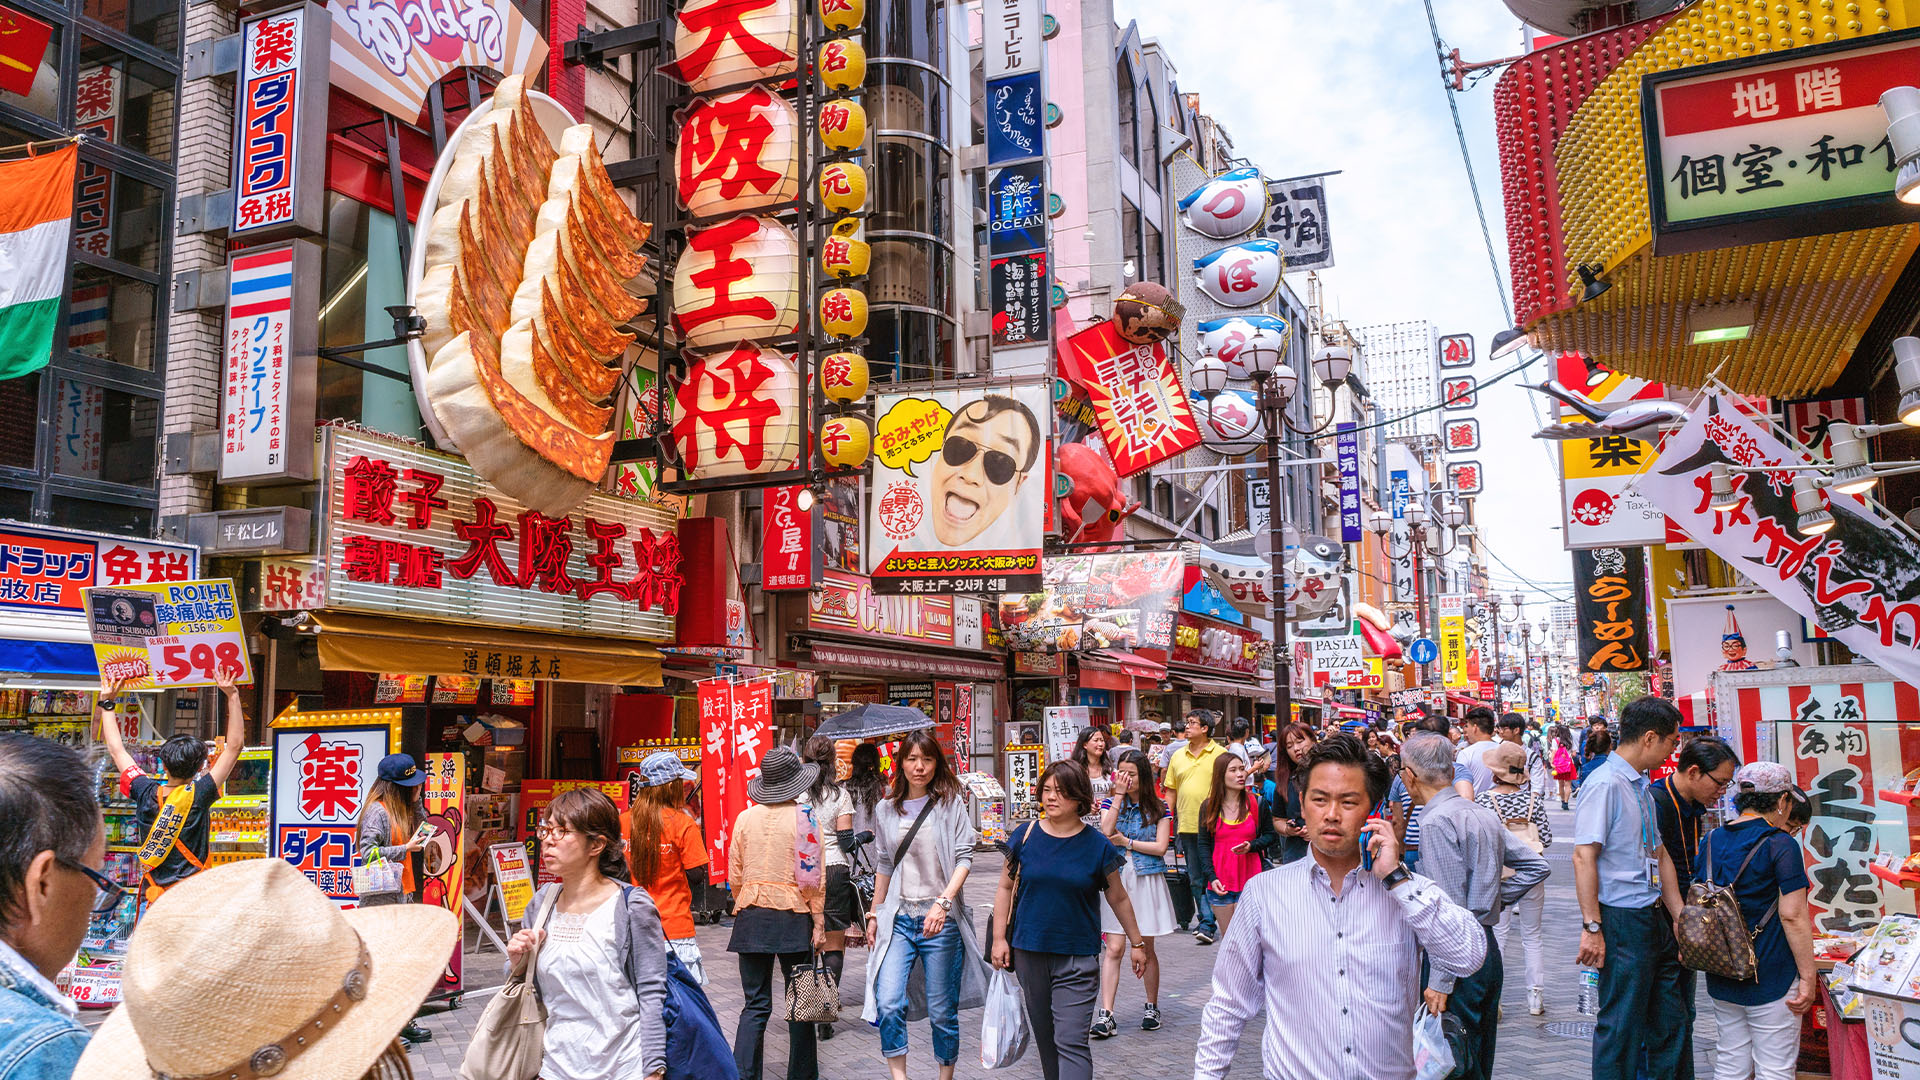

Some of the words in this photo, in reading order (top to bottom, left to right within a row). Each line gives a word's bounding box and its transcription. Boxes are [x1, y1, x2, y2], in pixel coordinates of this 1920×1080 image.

[1046, 18, 1053, 30] 5
[254, 19, 296, 70] 薬
[1732, 67, 1842, 119] 地階
[249, 76, 292, 192] ダイコク
[238, 192, 292, 227] 免税
[1002, 196, 1032, 211] BAR
[1051, 198, 1060, 209] 3
[991, 214, 1044, 231] OCEAN
[1267, 204, 1322, 249] 牛角
[1054, 289, 1062, 301] 2
[249, 316, 268, 434] クンテープ
[269, 321, 283, 450] タイ料理とタイスキの店
[236, 327, 250, 452] タイカルチャースクール
[880, 407, 940, 449] おみやげ
[268, 453, 279, 465] B1
[343, 455, 449, 530] 餃子
[1059, 480, 1068, 492] B
[1642, 510, 1664, 521] Sho
[223, 521, 278, 541] 平松ビル
[102, 544, 189, 585] 免税
[444, 496, 687, 616] 大阪王将
[885, 555, 1036, 571] よしもと芸人グッズ・大阪みやげ
[769, 574, 806, 585] 道頓堀店
[169, 584, 233, 603] ROIHI
[155, 602, 234, 624] 酸痛贴布
[860, 583, 924, 639] GAME
[1587, 575, 1642, 670] らーめん
[461, 651, 561, 680] 道頓堀本店
[1318, 656, 1360, 669] PIZZA
[703, 697, 726, 718] 餃子
[1800, 697, 1860, 720] 大阪
[1801, 729, 1864, 756] 名物
[302, 746, 360, 817] 薬
[425, 791, 456, 799] 213-0400
[284, 831, 361, 867] ダイコ
[508, 849, 518, 858] 2F
